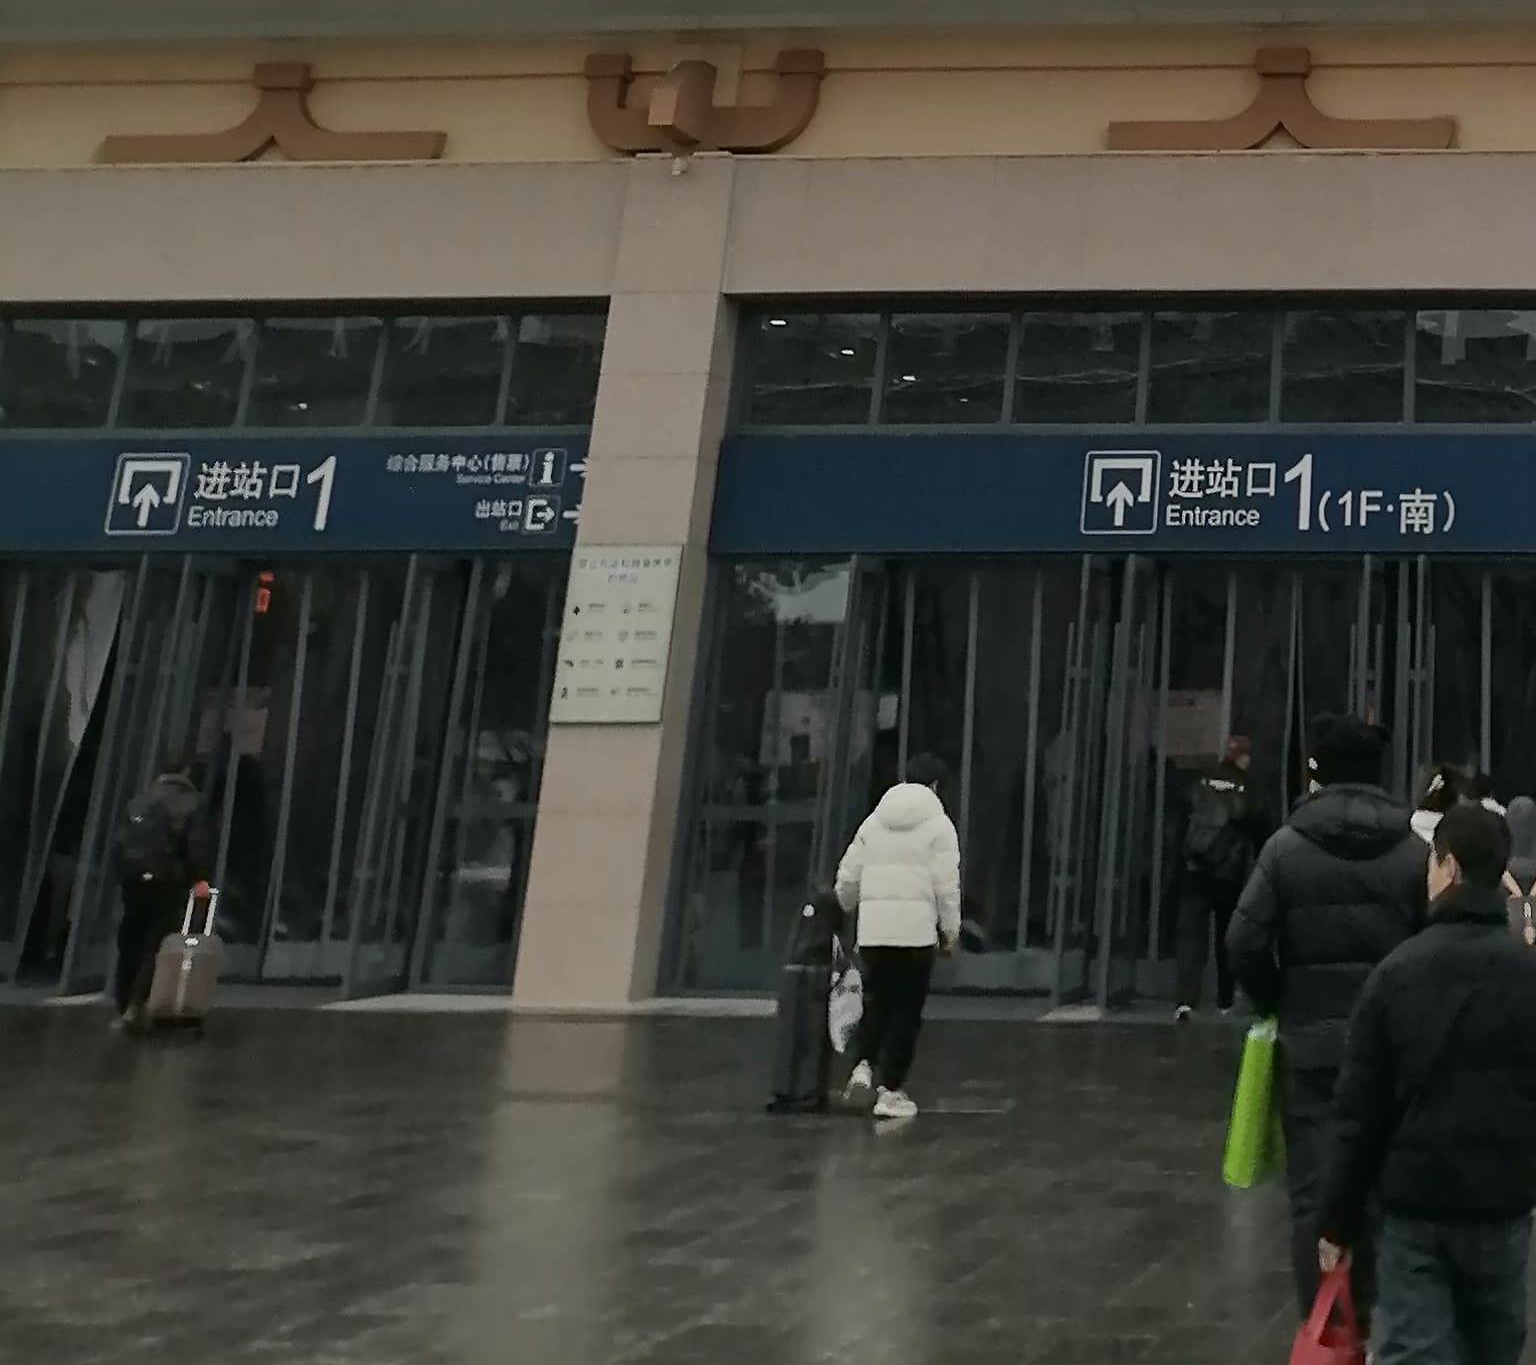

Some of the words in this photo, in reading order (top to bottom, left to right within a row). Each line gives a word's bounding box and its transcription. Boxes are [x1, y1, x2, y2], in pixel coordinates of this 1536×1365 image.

[194, 461, 301, 500] 进站口
[307, 455, 337, 531] 1
[1168, 458, 1277, 499] 进站口
[1284, 453, 1313, 531] 1
[188, 505, 279, 527] Entrance
[475, 498, 523, 519] 出站口
[1165, 504, 1261, 527] Entrance
